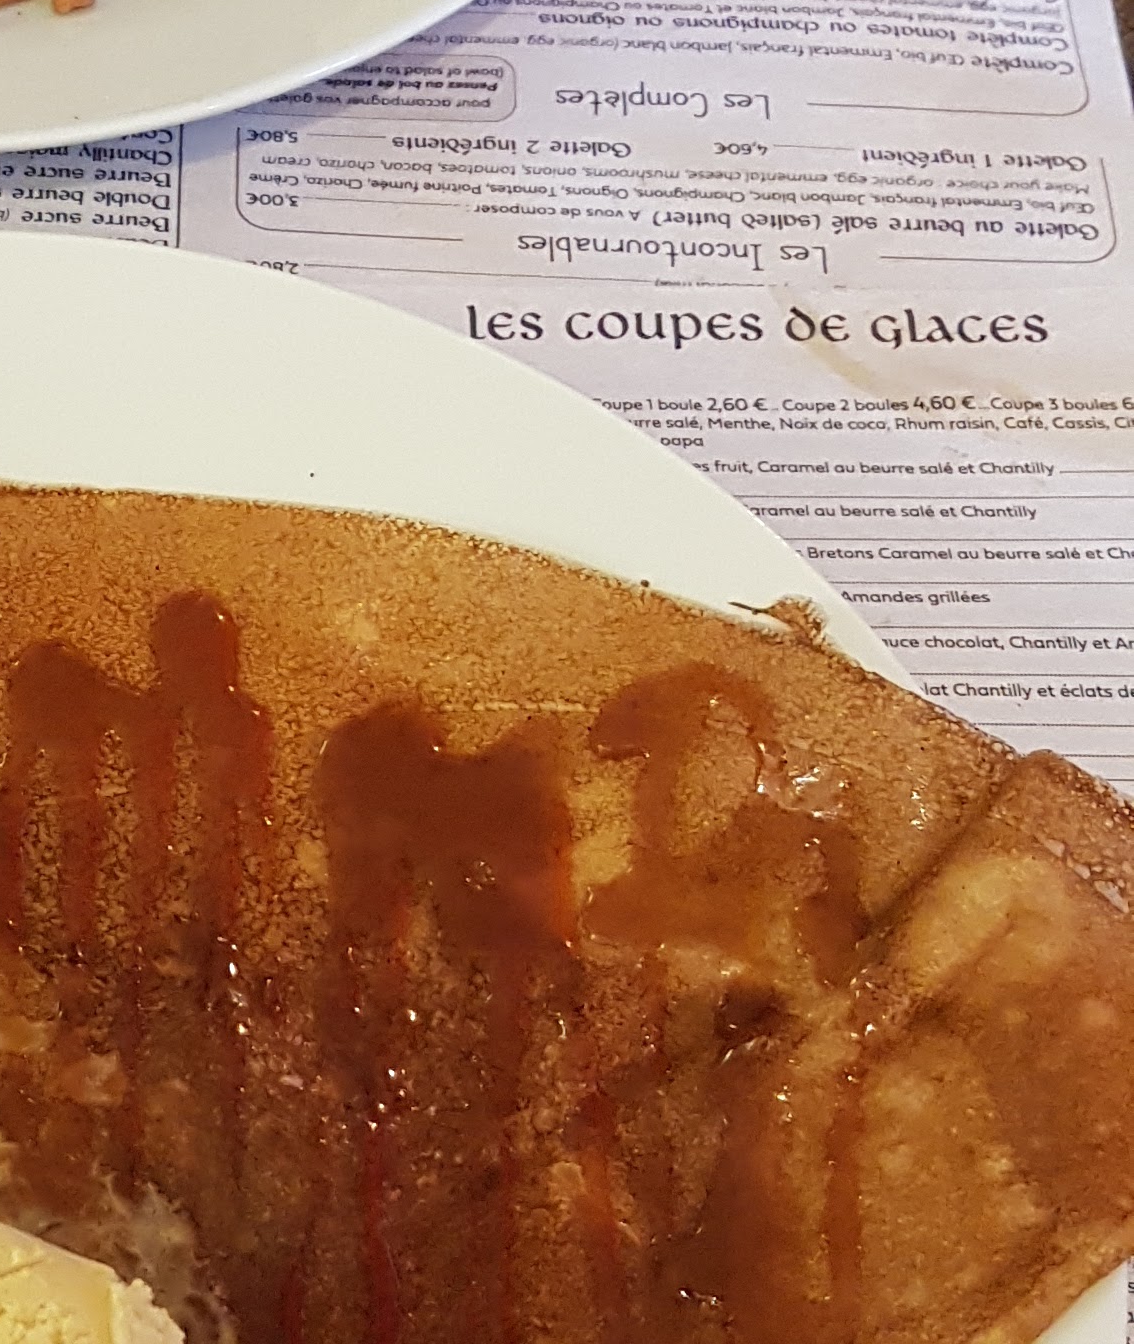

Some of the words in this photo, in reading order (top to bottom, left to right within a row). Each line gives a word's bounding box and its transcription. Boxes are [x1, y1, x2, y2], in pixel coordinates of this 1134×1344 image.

[554, 80, 709, 119] Complètes
[723, 93, 771, 121] Les
[244, 129, 299, 144] 5,80€
[391, 135, 517, 156] ingrédients
[526, 139, 540, 155] 2
[549, 140, 632, 159] Galette
[20, 210, 82, 225] sucre
[91, 213, 170, 233] Beurre
[652, 210, 731, 230] butter)
[741, 213, 821, 231] (salted
[831, 215, 878, 235] salé
[888, 217, 965, 237] beurre
[974, 220, 1004, 234] au
[1014, 221, 1100, 241] Galette
[517, 234, 765, 272] Incontournables
[779, 244, 828, 275] Les
[648, 398, 654, 412] 1
[657, 398, 703, 412] boule
[781, 398, 837, 415] Coupe
[839, 398, 851, 412] 2
[853, 398, 910, 412] boules
[989, 396, 1045, 413] Coupe
[1048, 397, 1060, 411] 3
[1062, 398, 1119, 411] boules
[665, 416, 703, 431] salé,
[707, 417, 776, 432] Menthe,
[778, 417, 819, 430] Noix
[821, 417, 844, 430] de
[846, 420, 891, 432] coco,
[894, 416, 946, 430] Rhum
[948, 419, 1000, 432] raisin,
[1003, 416, 1049, 431] Café,
[1051, 416, 1111, 431] Cassis,
[713, 459, 754, 475] fruit,
[757, 460, 830, 474] Caramel
[833, 464, 856, 474] au
[858, 461, 915, 475] beurre
[918, 461, 954, 475] salé
[957, 463, 976, 475] et
[978, 461, 1055, 477] Chantilly
